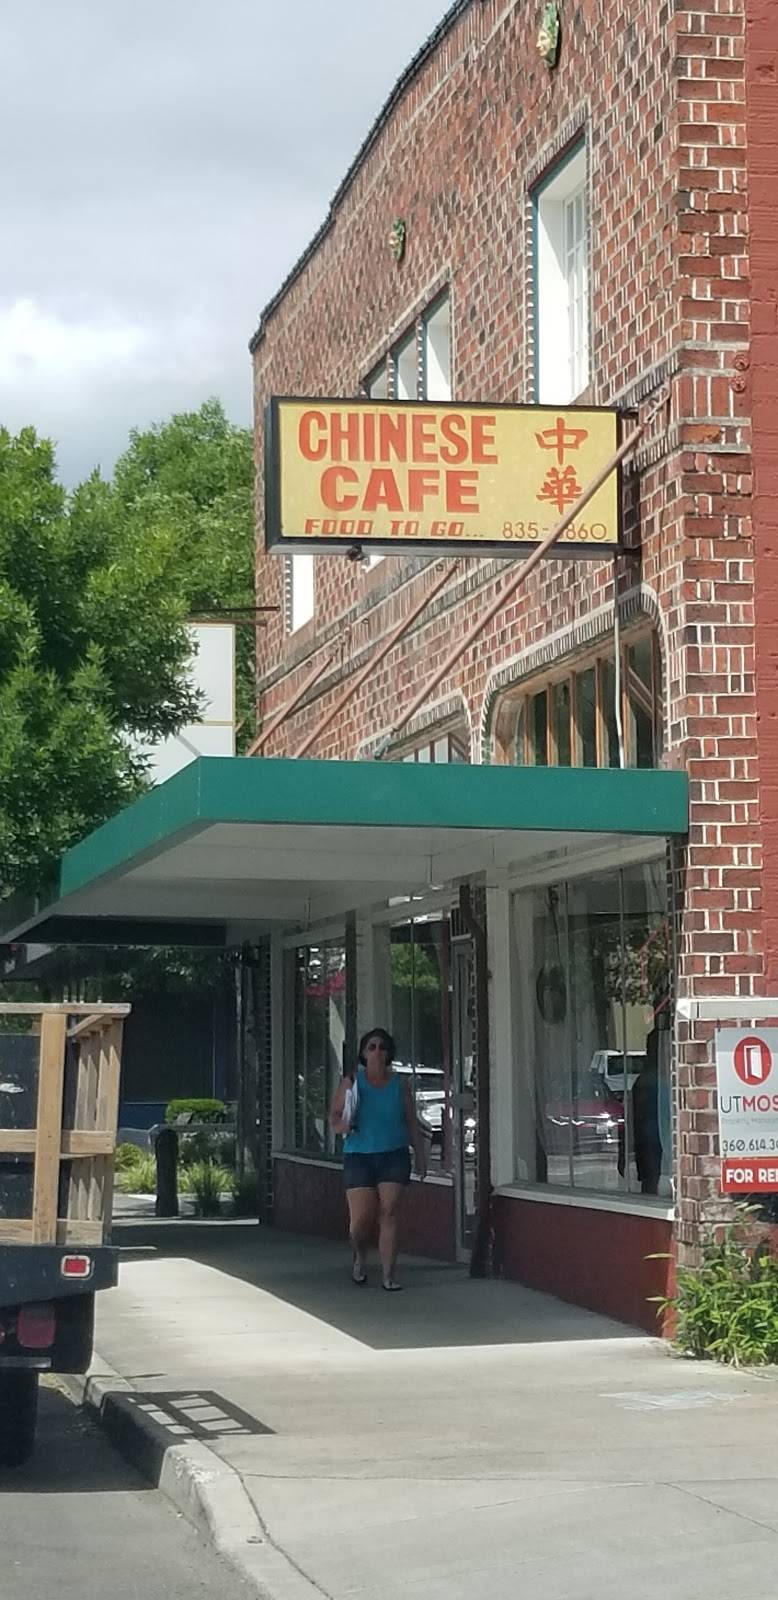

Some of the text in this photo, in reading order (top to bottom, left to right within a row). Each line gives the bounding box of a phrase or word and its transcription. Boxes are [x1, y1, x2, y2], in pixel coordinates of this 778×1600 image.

[298, 410, 499, 465] CHINESE
[534, 416, 589, 515] 中華
[320, 465, 480, 513] CAFE
[304, 519, 373, 536] FOOD
[390, 520, 420, 537] TO
[502, 521, 608, 541] 835-860
[726, 1167, 778, 1184] FOR RE
